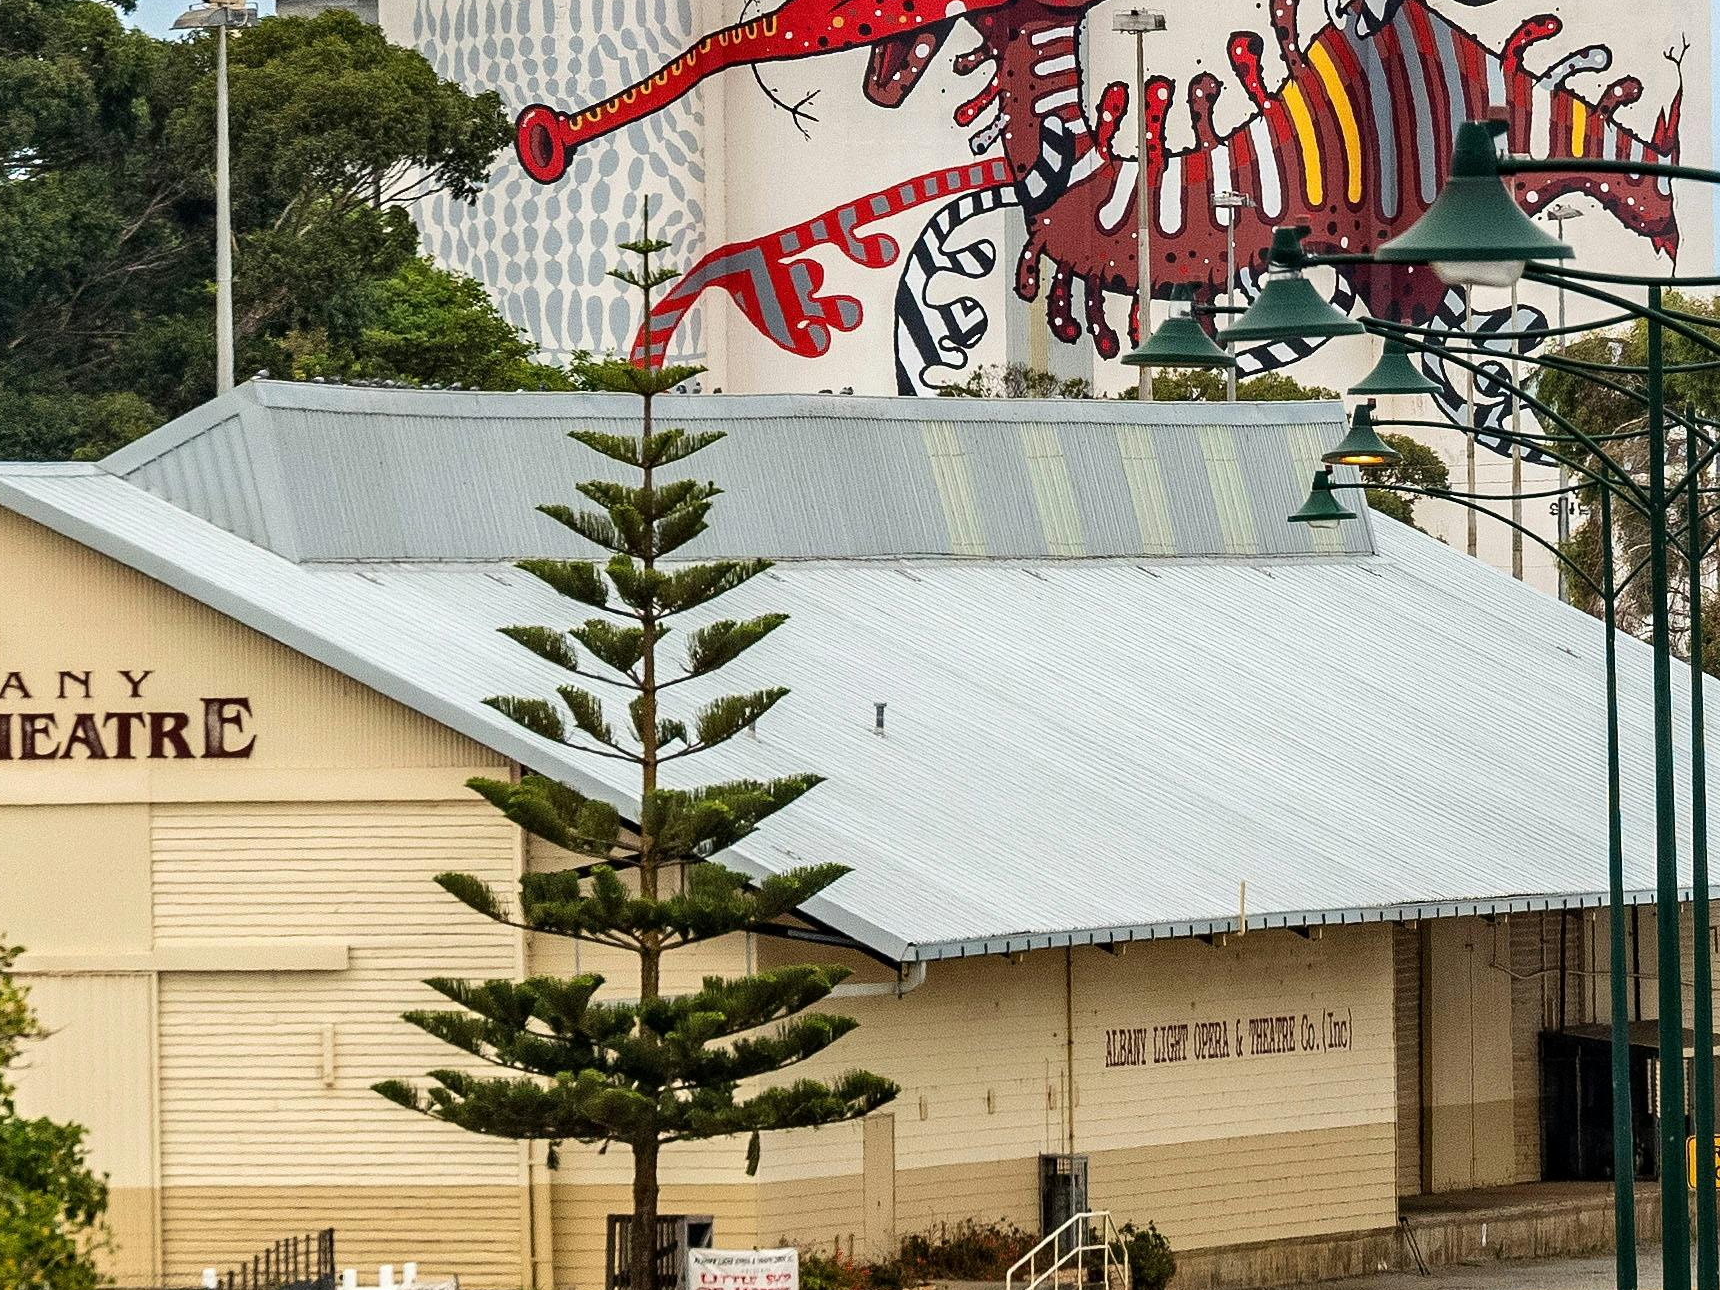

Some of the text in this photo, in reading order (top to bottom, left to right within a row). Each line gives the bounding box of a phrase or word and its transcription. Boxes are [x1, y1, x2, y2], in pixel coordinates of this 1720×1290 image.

[1105, 1008, 1352, 1067] ALBANY LIGHT OPERA & THEATRE Co. (Inc)
